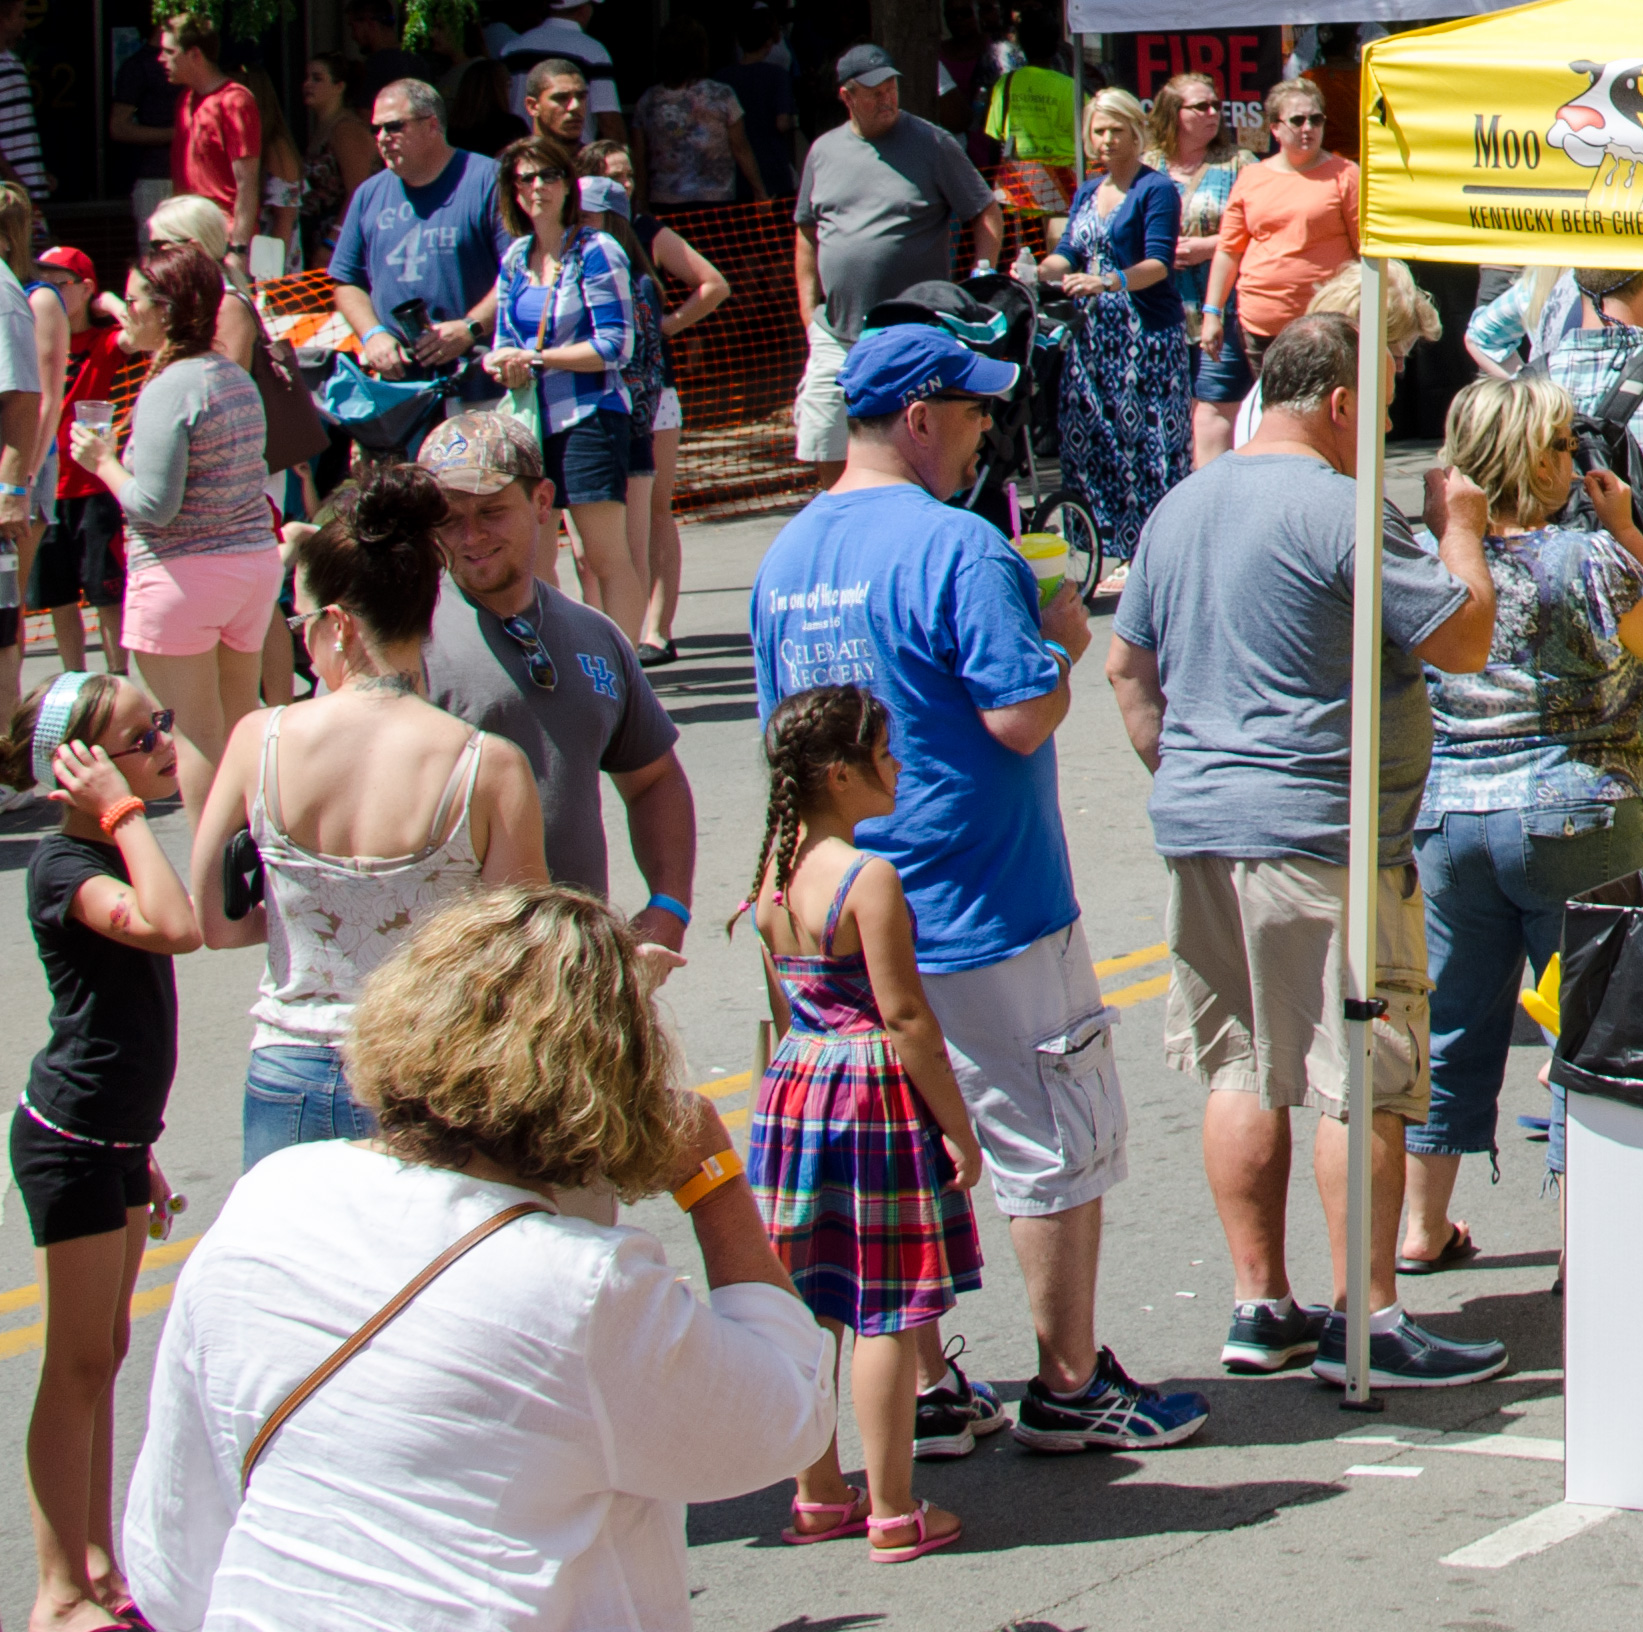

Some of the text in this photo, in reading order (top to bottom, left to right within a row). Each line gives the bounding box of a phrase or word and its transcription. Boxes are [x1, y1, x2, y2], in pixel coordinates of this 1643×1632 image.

[1137, 35, 1260, 101] FIRE
[1473, 113, 1541, 169] Moo
[377, 201, 415, 230] GO
[1469, 205, 1555, 233] KENTUCKY
[1562, 210, 1605, 235] BEER
[386, 223, 459, 282] 4TH
[770, 587, 787, 614] I'm
[807, 582, 820, 614] of
[780, 638, 872, 666] CELEBATE
[576, 652, 618, 701] UK
